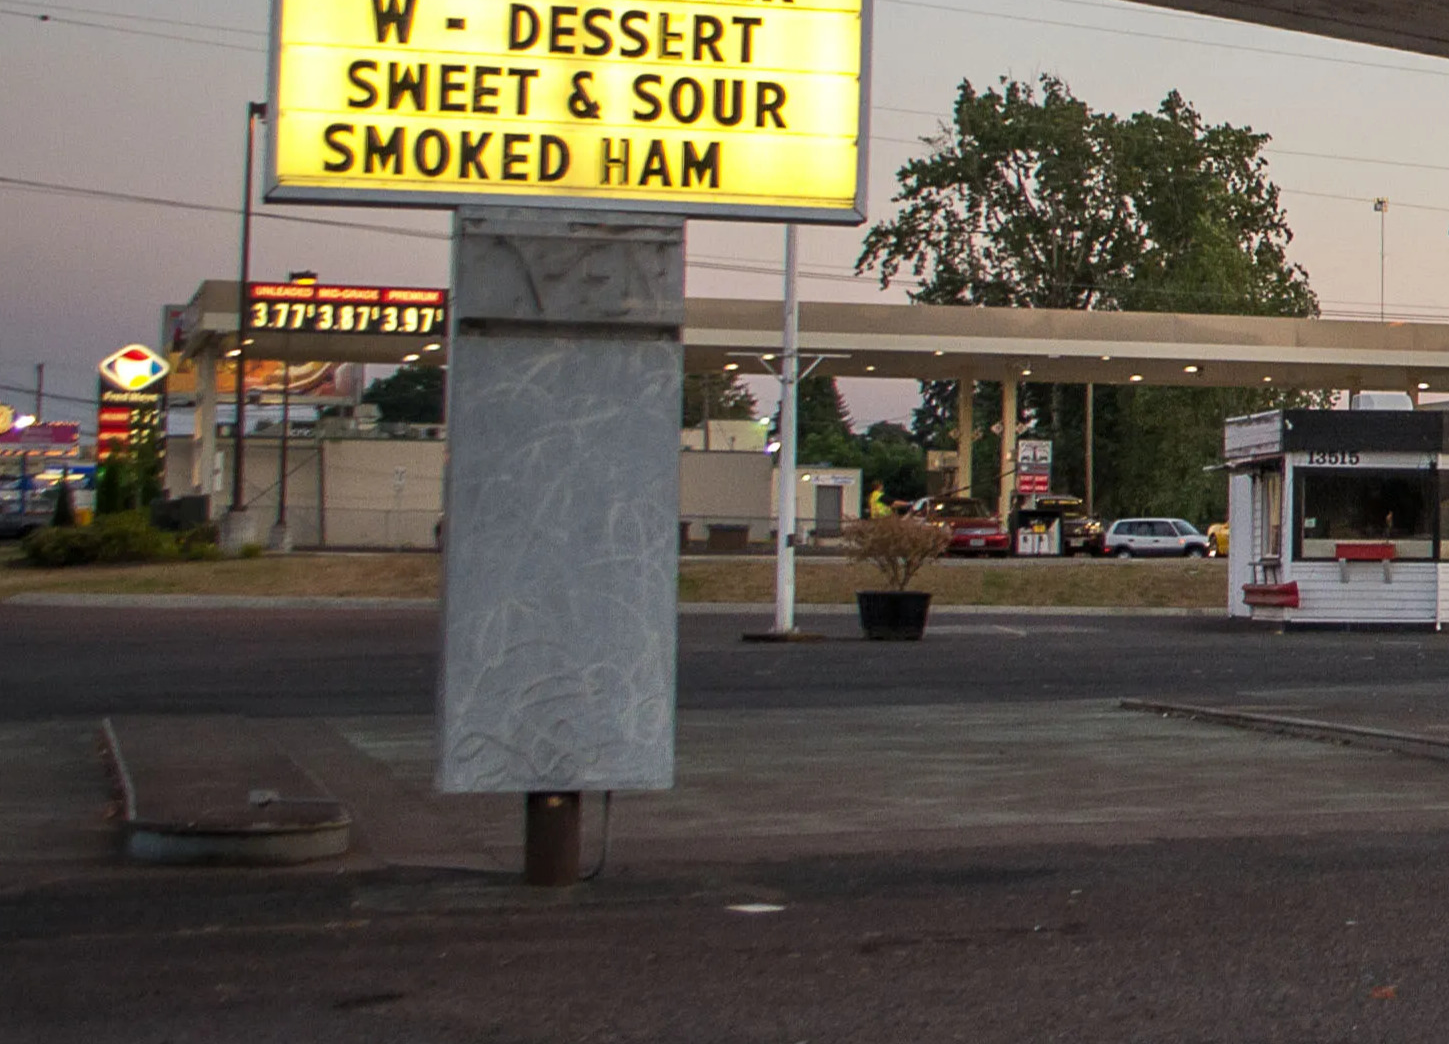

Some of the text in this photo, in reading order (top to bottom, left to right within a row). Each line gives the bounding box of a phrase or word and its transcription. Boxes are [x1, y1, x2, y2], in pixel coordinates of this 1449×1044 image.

[507, 3, 764, 65] DESSERT
[346, 59, 788, 129] SWEET & SOUR
[322, 122, 722, 190] SMOKED HAM
[1308, 451, 1359, 464] 13515
